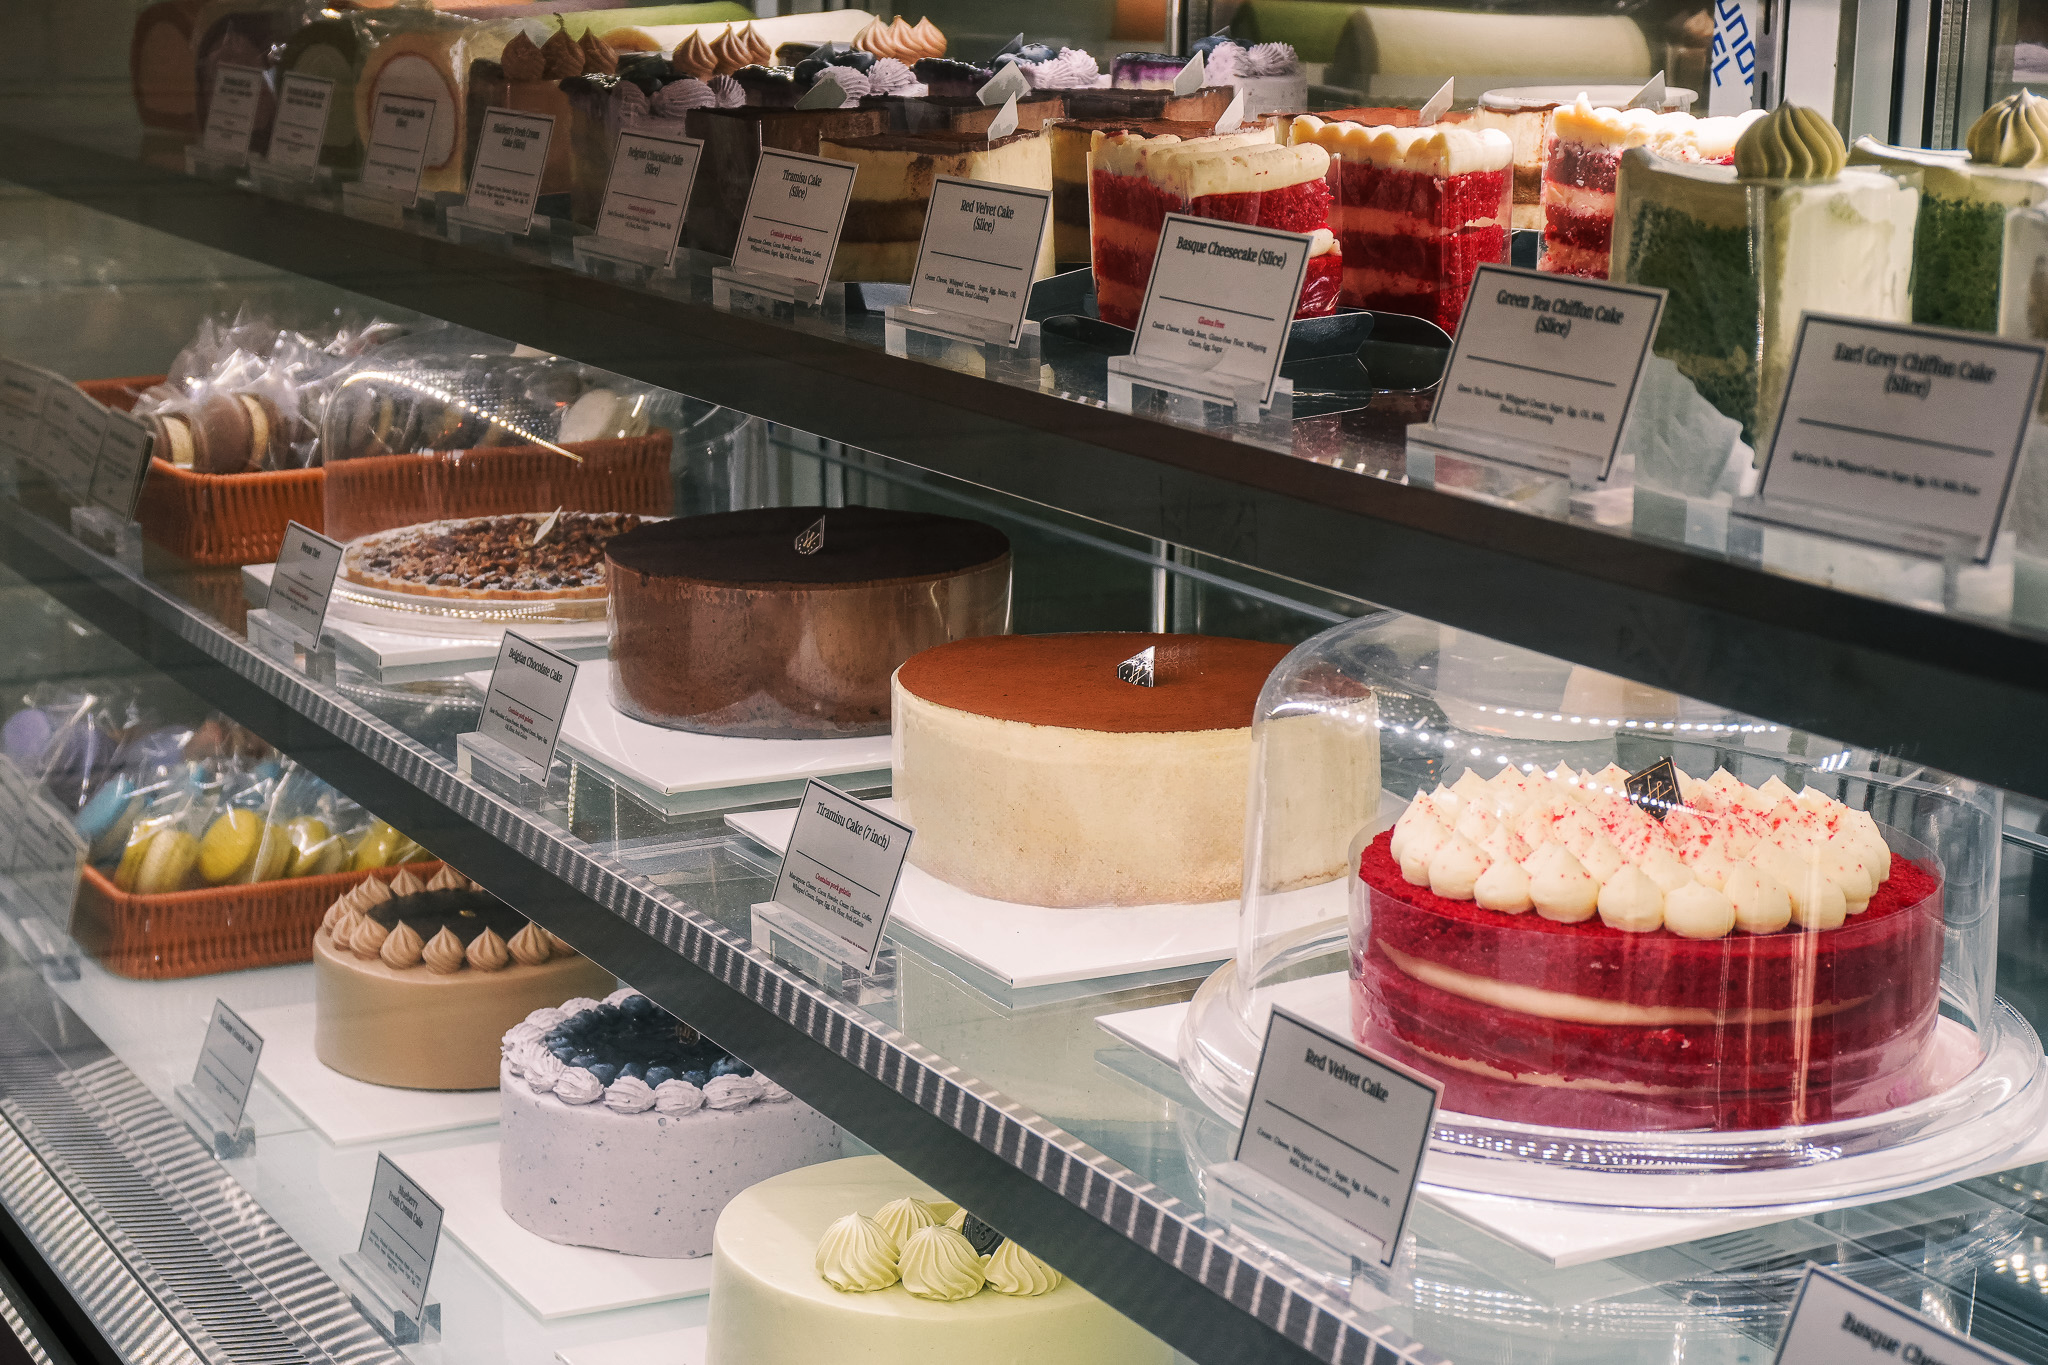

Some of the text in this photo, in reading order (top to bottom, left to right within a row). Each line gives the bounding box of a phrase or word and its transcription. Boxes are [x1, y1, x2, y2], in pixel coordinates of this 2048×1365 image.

[645, 166, 660, 177] (Slice)
[671, 155, 683, 166] Cake
[783, 170, 822, 187] Tiramisu Cake
[789, 187, 807, 200] (Slice)
[961, 200, 1014, 219] Red Velvet Cake
[973, 217, 995, 234] (Slice)
[1177, 237, 1287, 269] Basque Cheesecake (Slice)
[1497, 290, 1624, 324] Green Tea Chiffon Cake
[1535, 318, 1571, 340] (Slice)
[1834, 344, 1996, 383] Earl Grey Chiffon Cake
[1885, 377, 1930, 399] (Slice)
[509, 648, 562, 683] Belgian Chocolate Cake
[817, 802, 890, 851] Tiramisu Cake (7 inch)
[815, 873, 851, 897] Contains pork gelatin
[1305, 1049, 1388, 1101] Red Velvet Cake
[1841, 1311, 1900, 1355] Basque
